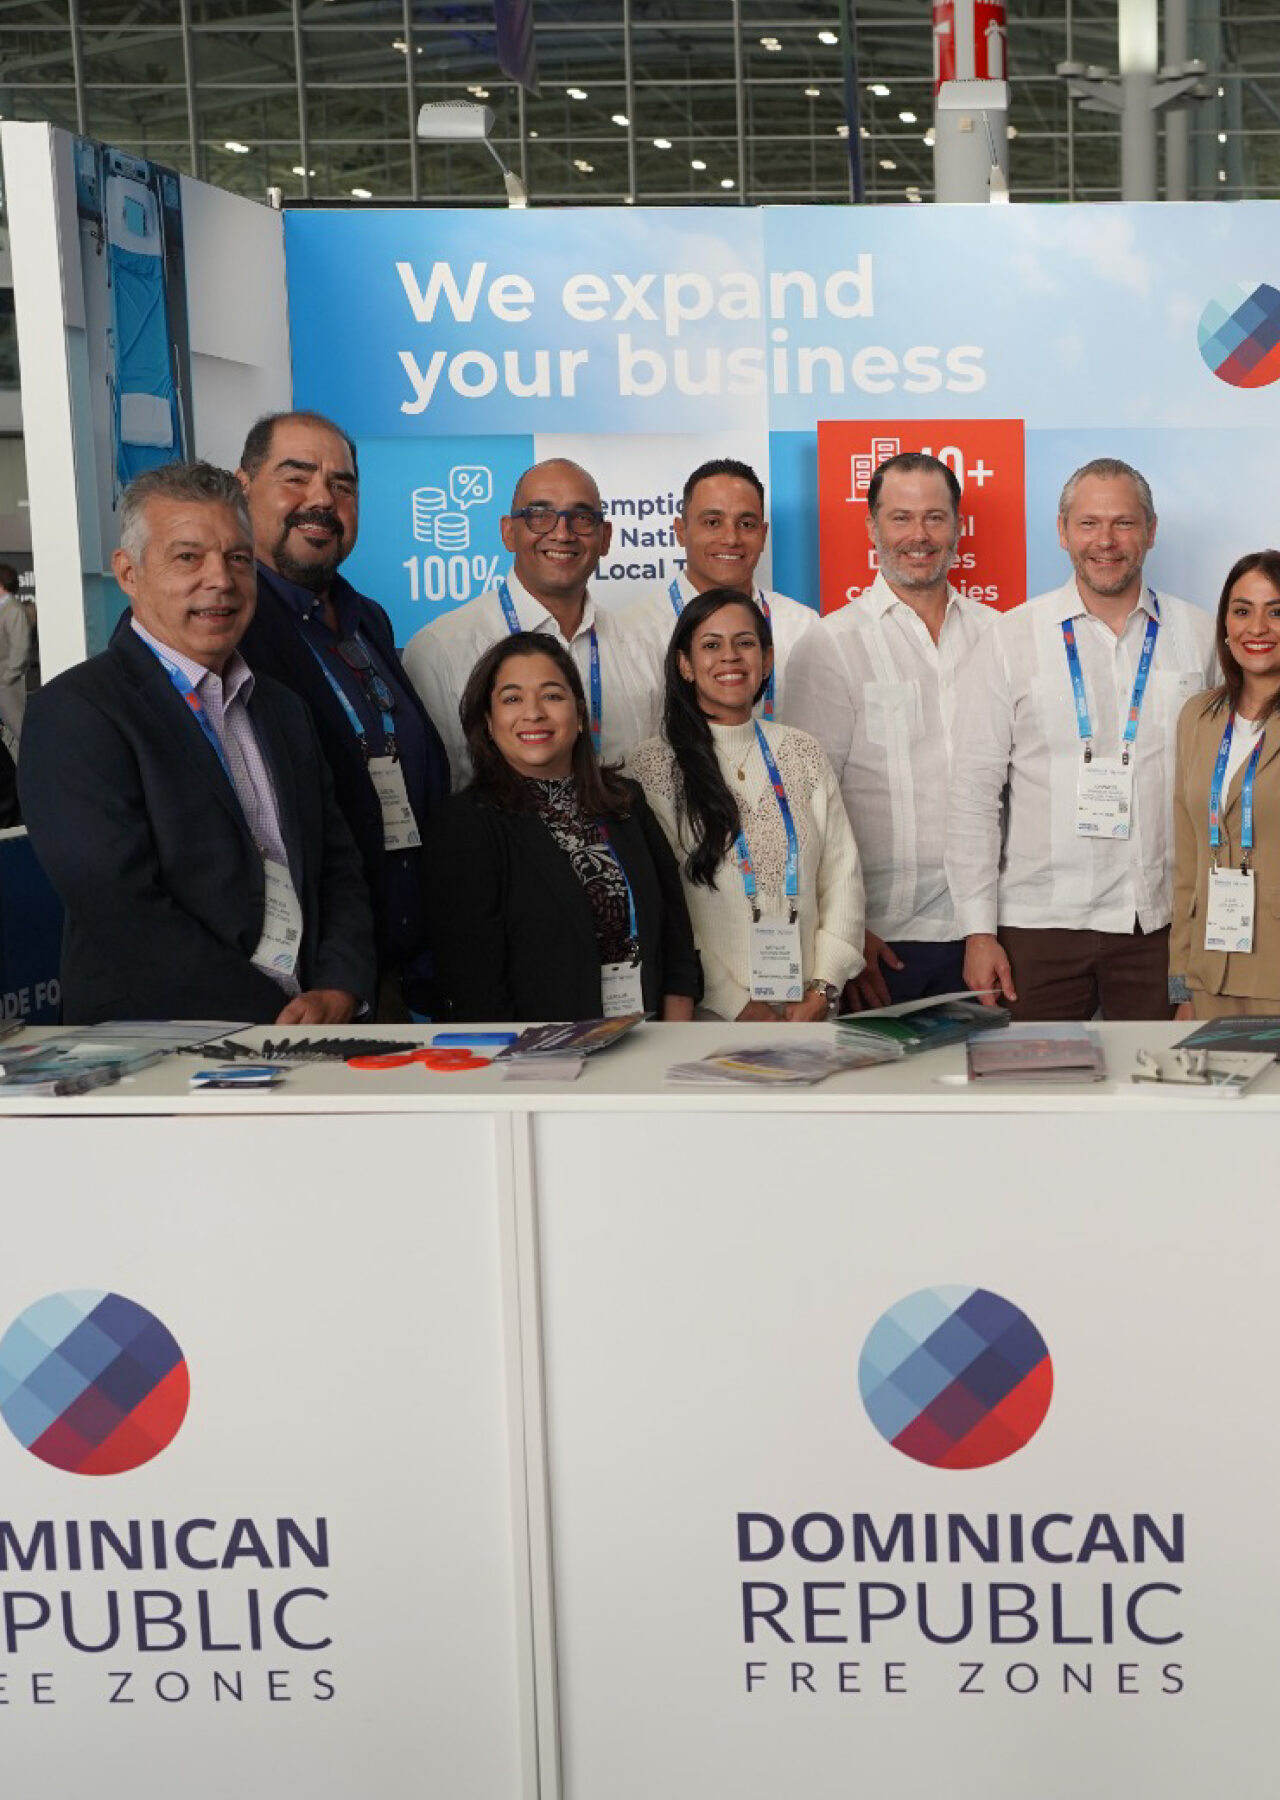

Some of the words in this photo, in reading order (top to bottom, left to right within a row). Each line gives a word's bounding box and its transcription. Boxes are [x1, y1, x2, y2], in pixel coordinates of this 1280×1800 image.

[396, 261, 536, 323] We
[561, 253, 874, 334] expand
[398, 347, 588, 414] your
[619, 329, 986, 396] business
[403, 555, 505, 602] 100%
[595, 557, 665, 580] Local
[737, 1511, 1186, 1564] DOMINICAN
[741, 1581, 1185, 1646] REPUBLIC
[109, 1669, 336, 1704] ZONES
[745, 1661, 908, 1694] FREE
[959, 1661, 1185, 1695] ZONES
